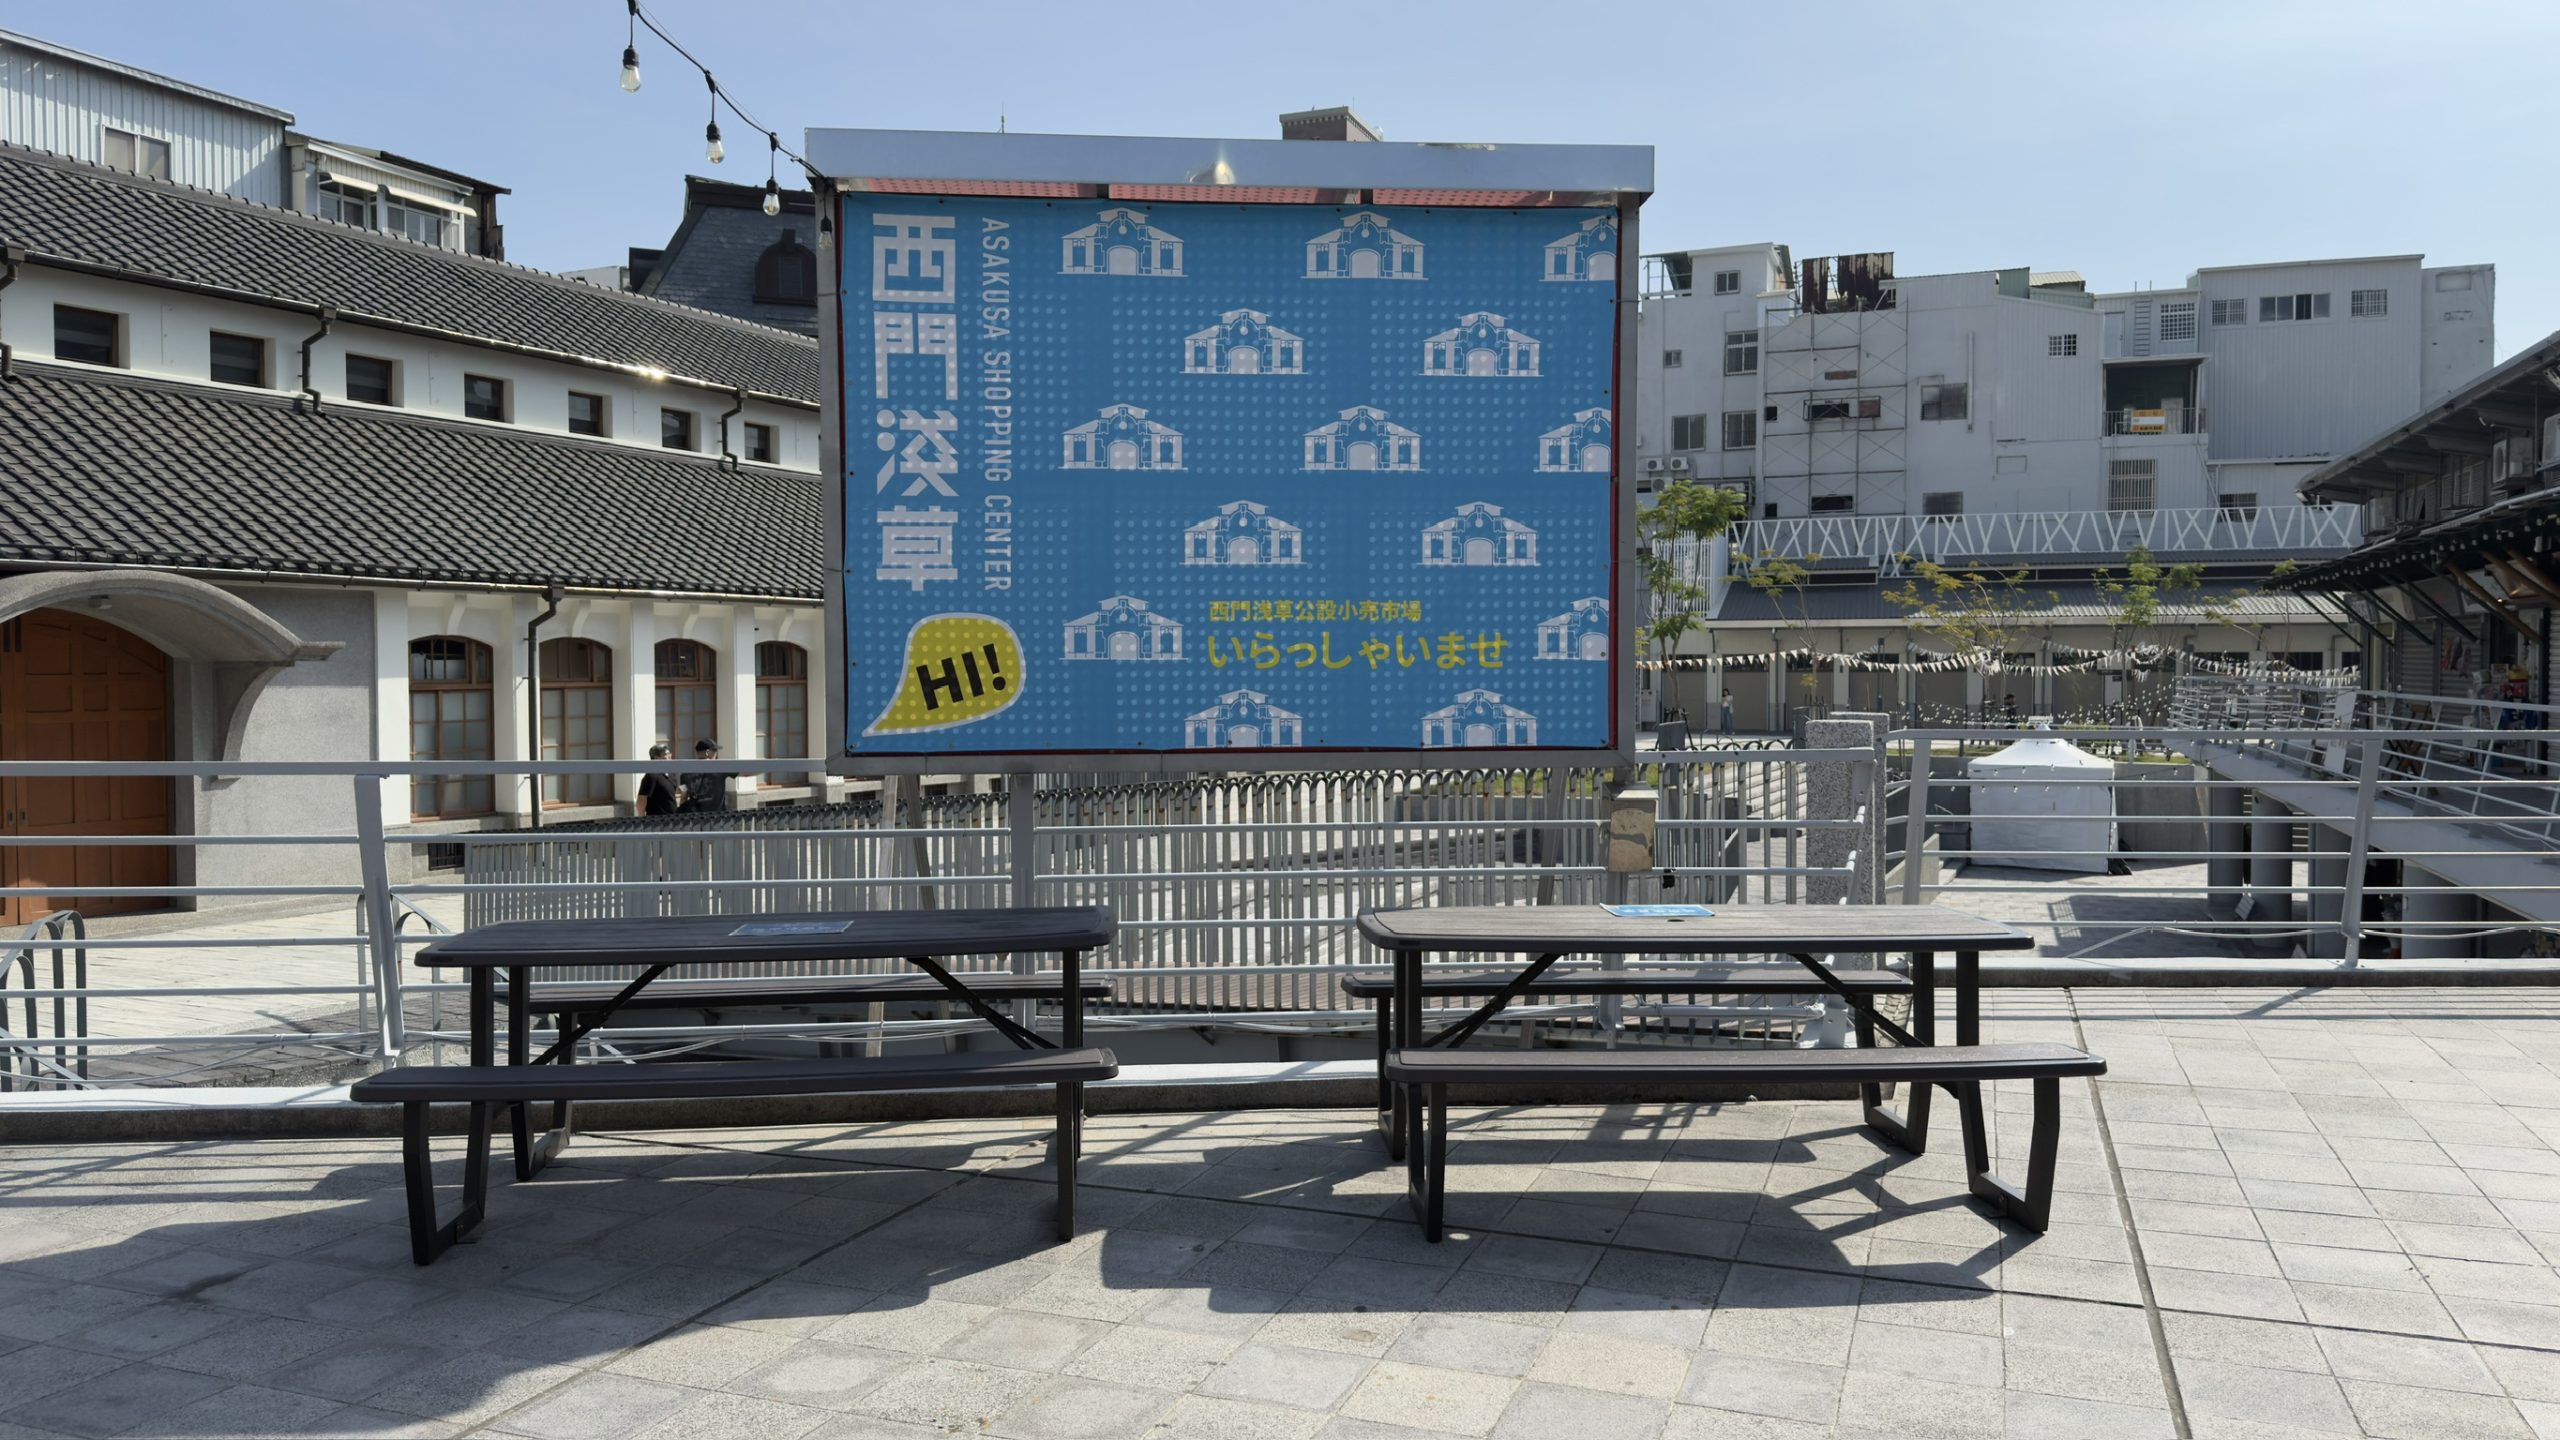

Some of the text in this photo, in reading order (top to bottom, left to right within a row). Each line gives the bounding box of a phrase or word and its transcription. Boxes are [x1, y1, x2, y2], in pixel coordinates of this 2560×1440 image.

[982, 217, 1012, 591] ASAKUSA SHOPPING CENTER
[916, 643, 1006, 711] HI!
[1208, 631, 1508, 669] いらっしゃいませ
